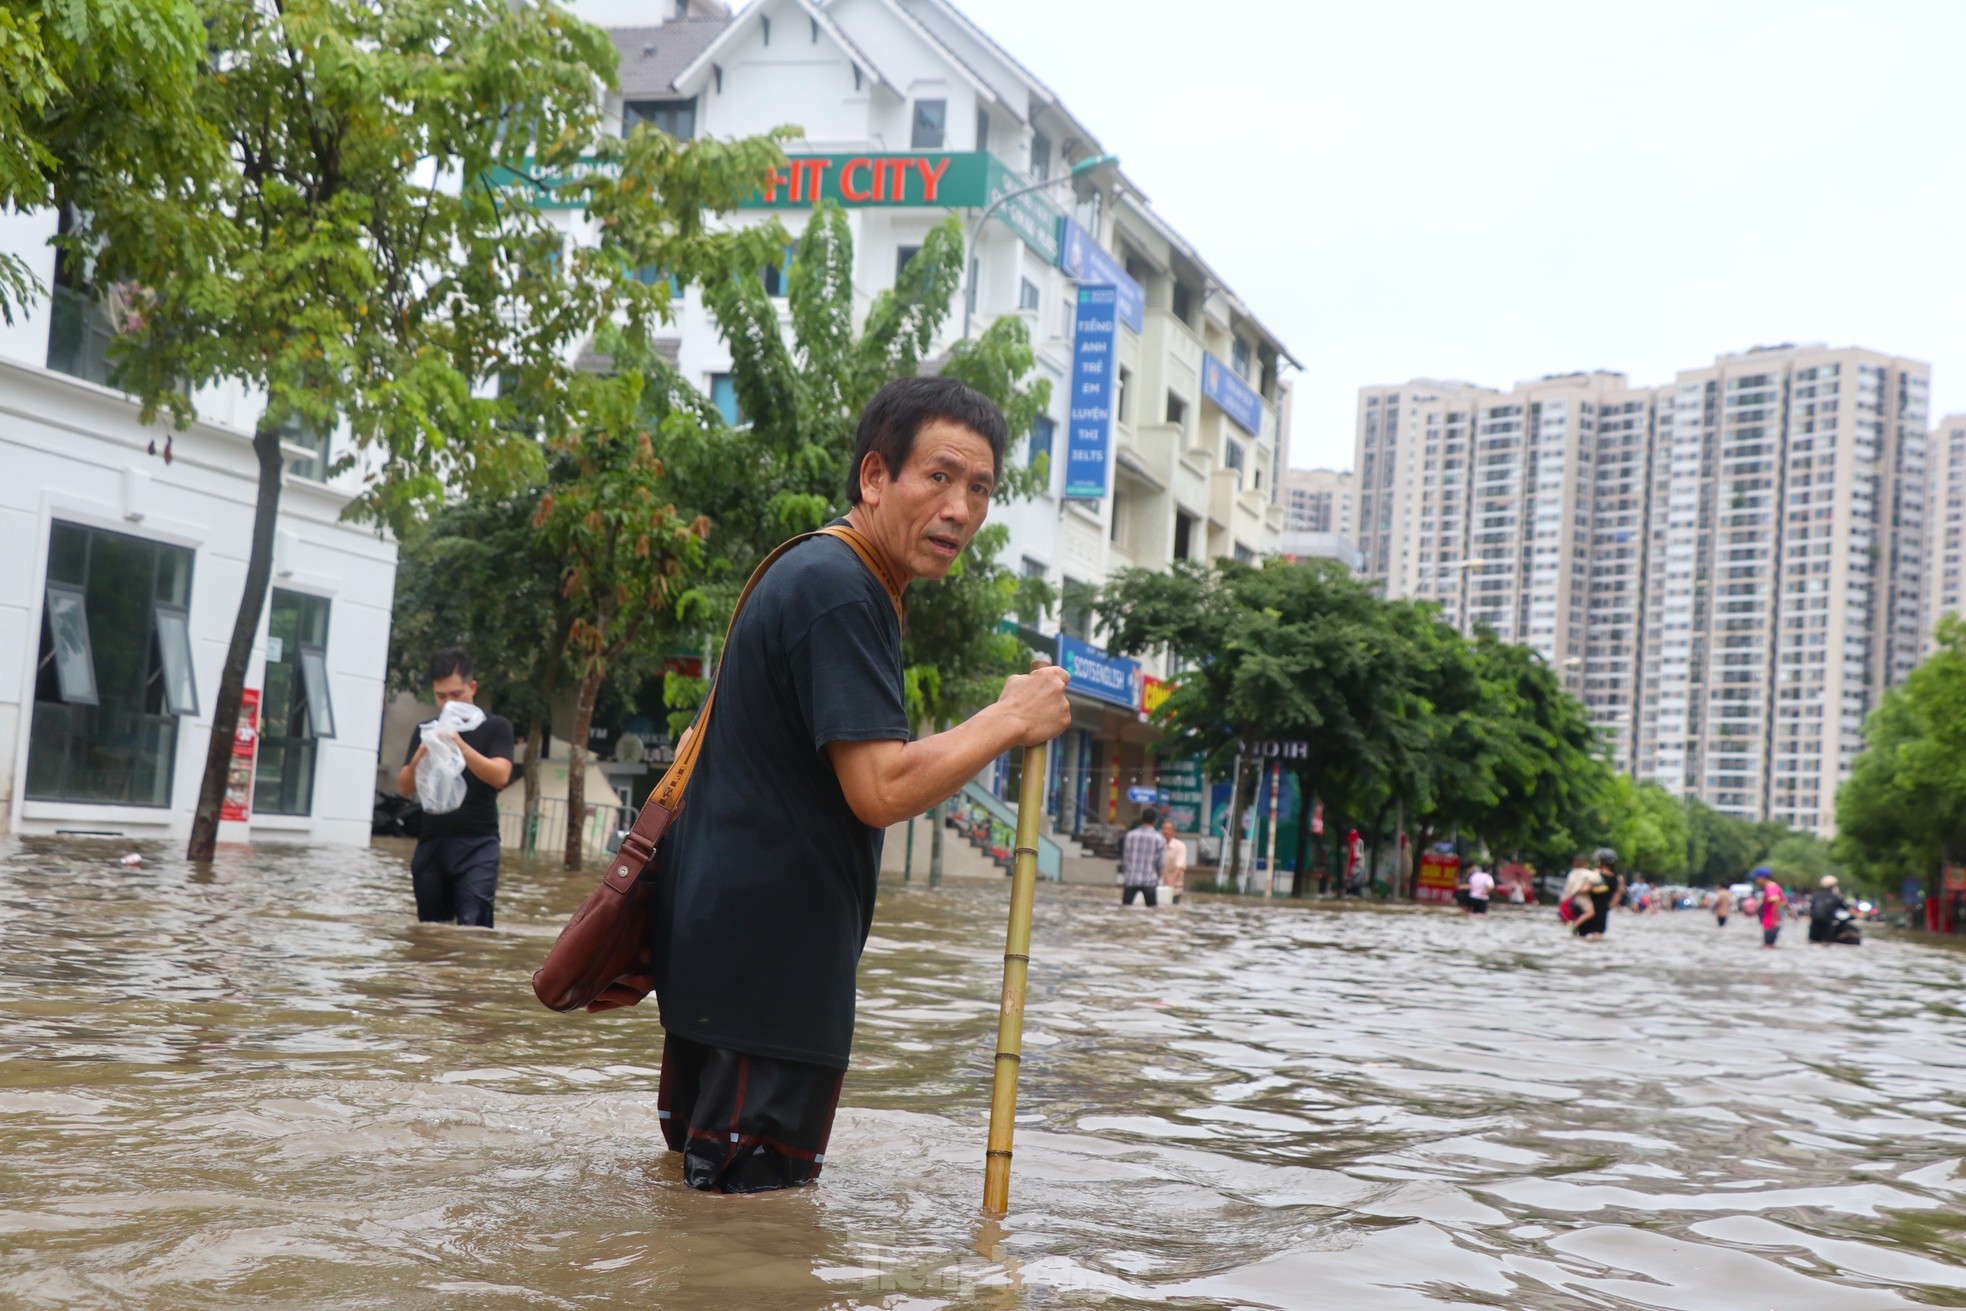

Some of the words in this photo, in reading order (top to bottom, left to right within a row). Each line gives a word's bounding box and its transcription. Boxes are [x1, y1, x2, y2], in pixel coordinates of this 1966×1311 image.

[839, 157, 950, 202] CITY
[1081, 341, 1107, 352] ANH
[1082, 382, 1101, 394] EM
[1078, 428, 1099, 440] THI
[1072, 449, 1104, 462] IELTS
